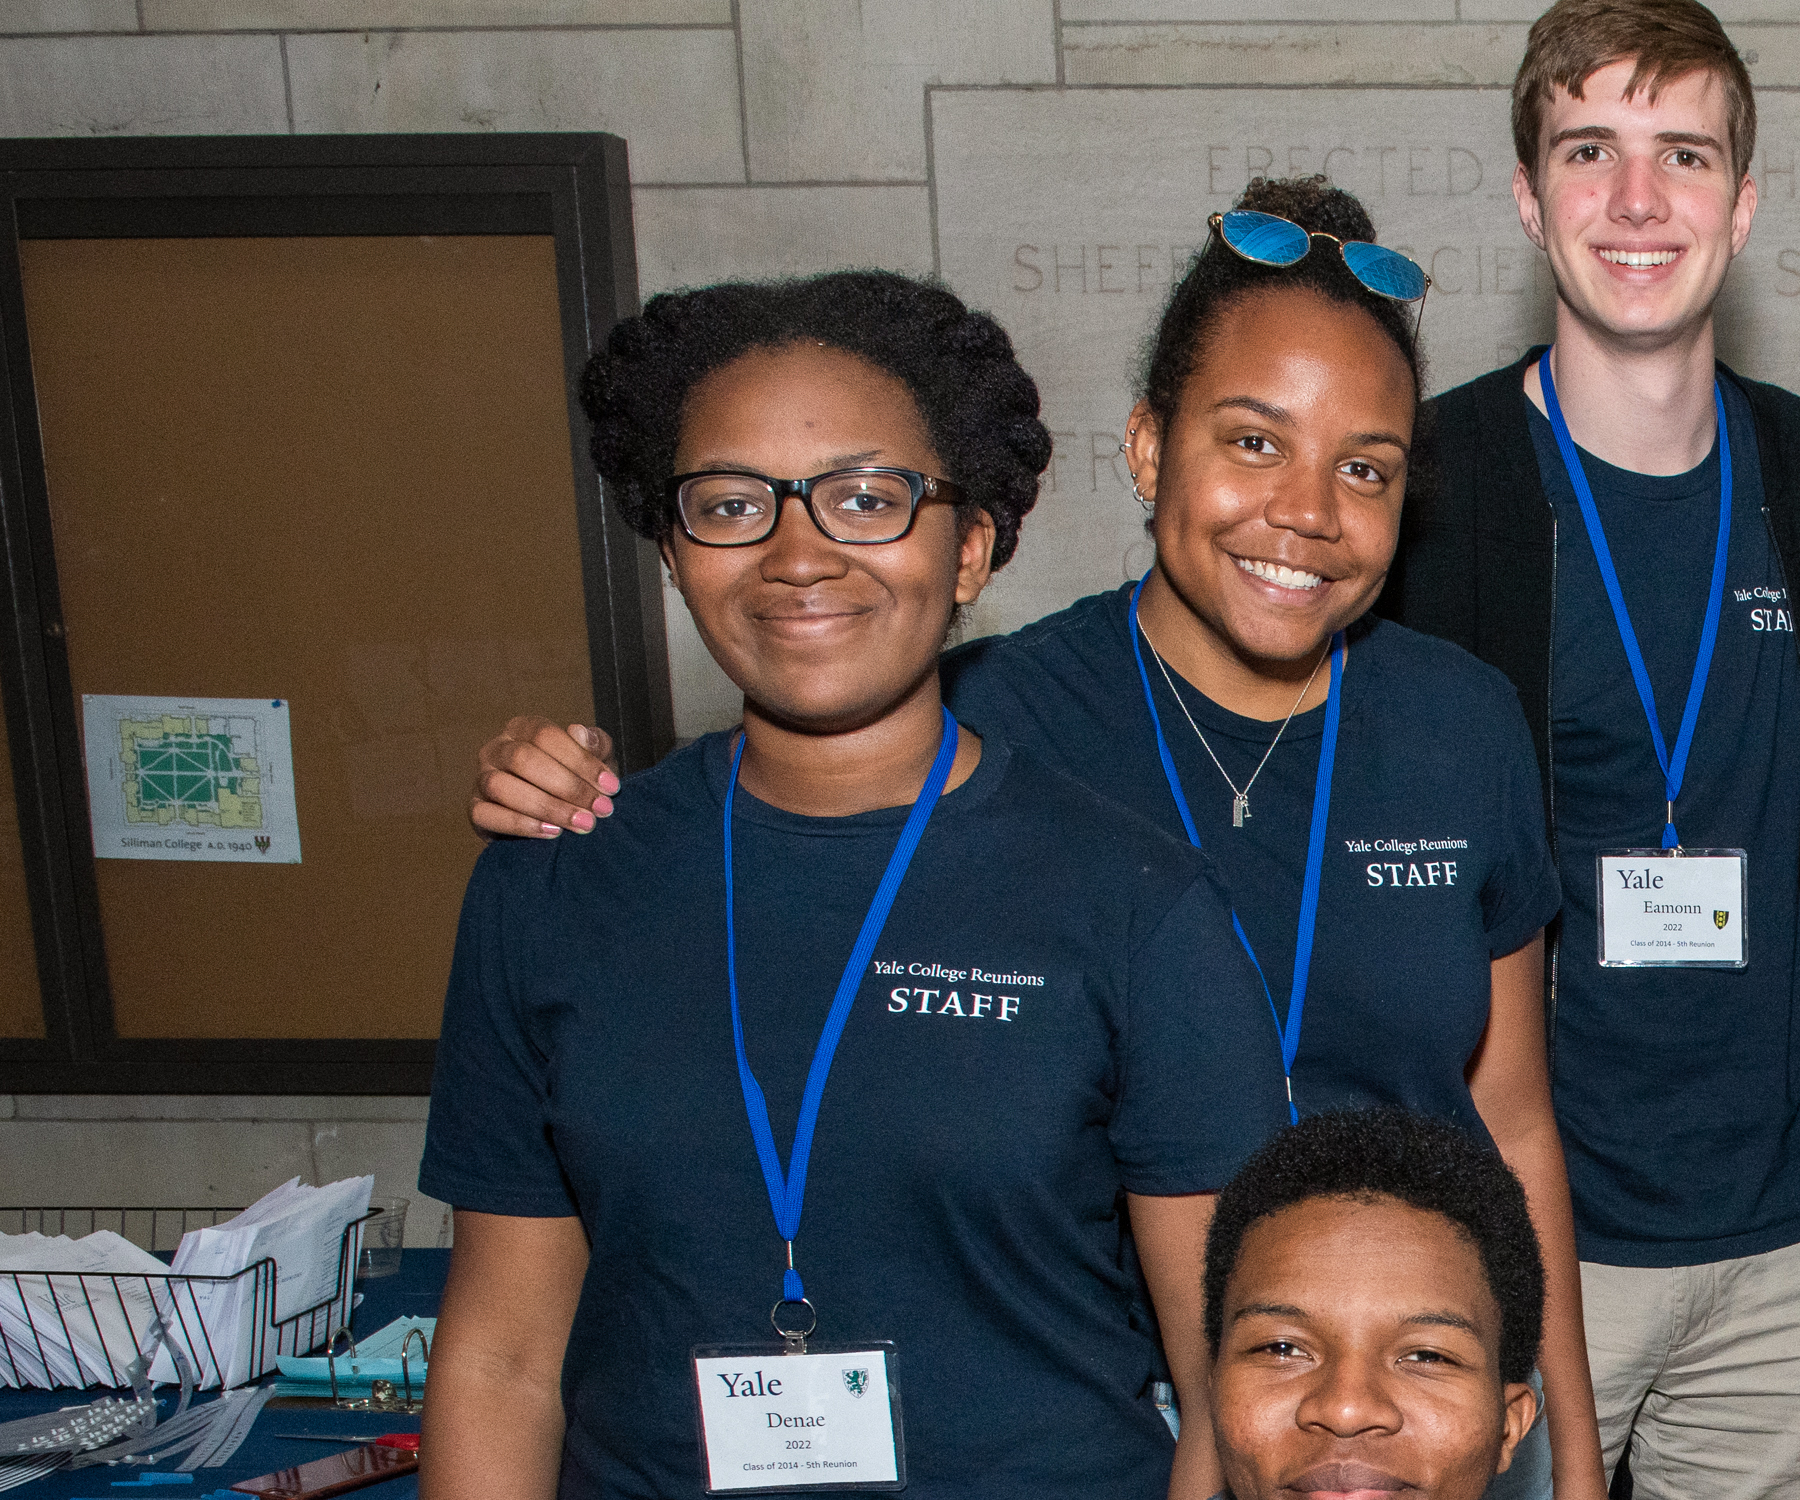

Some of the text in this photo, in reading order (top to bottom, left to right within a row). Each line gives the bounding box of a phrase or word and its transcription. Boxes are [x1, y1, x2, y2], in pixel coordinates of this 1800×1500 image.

[1207, 146, 1484, 197] ERECTED
[1734, 589, 1752, 601] Yale
[121, 838, 162, 849] Silliman
[165, 839, 202, 851] College
[1345, 837, 1468, 855] Yale College Reunions
[1366, 861, 1458, 887] STAFF
[1617, 869, 1664, 889] Yale
[1643, 901, 1702, 914] Eamonn
[874, 961, 1045, 986] Yale College Reunions
[888, 988, 1020, 1021] STAFF
[718, 1371, 783, 1397] Yale
[766, 1412, 826, 1428] Denae
[785, 1441, 811, 1449] 2022
[767, 1462, 775, 1470] of
[806, 1461, 820, 1469] 5th
[824, 1460, 857, 1468] Reunion
